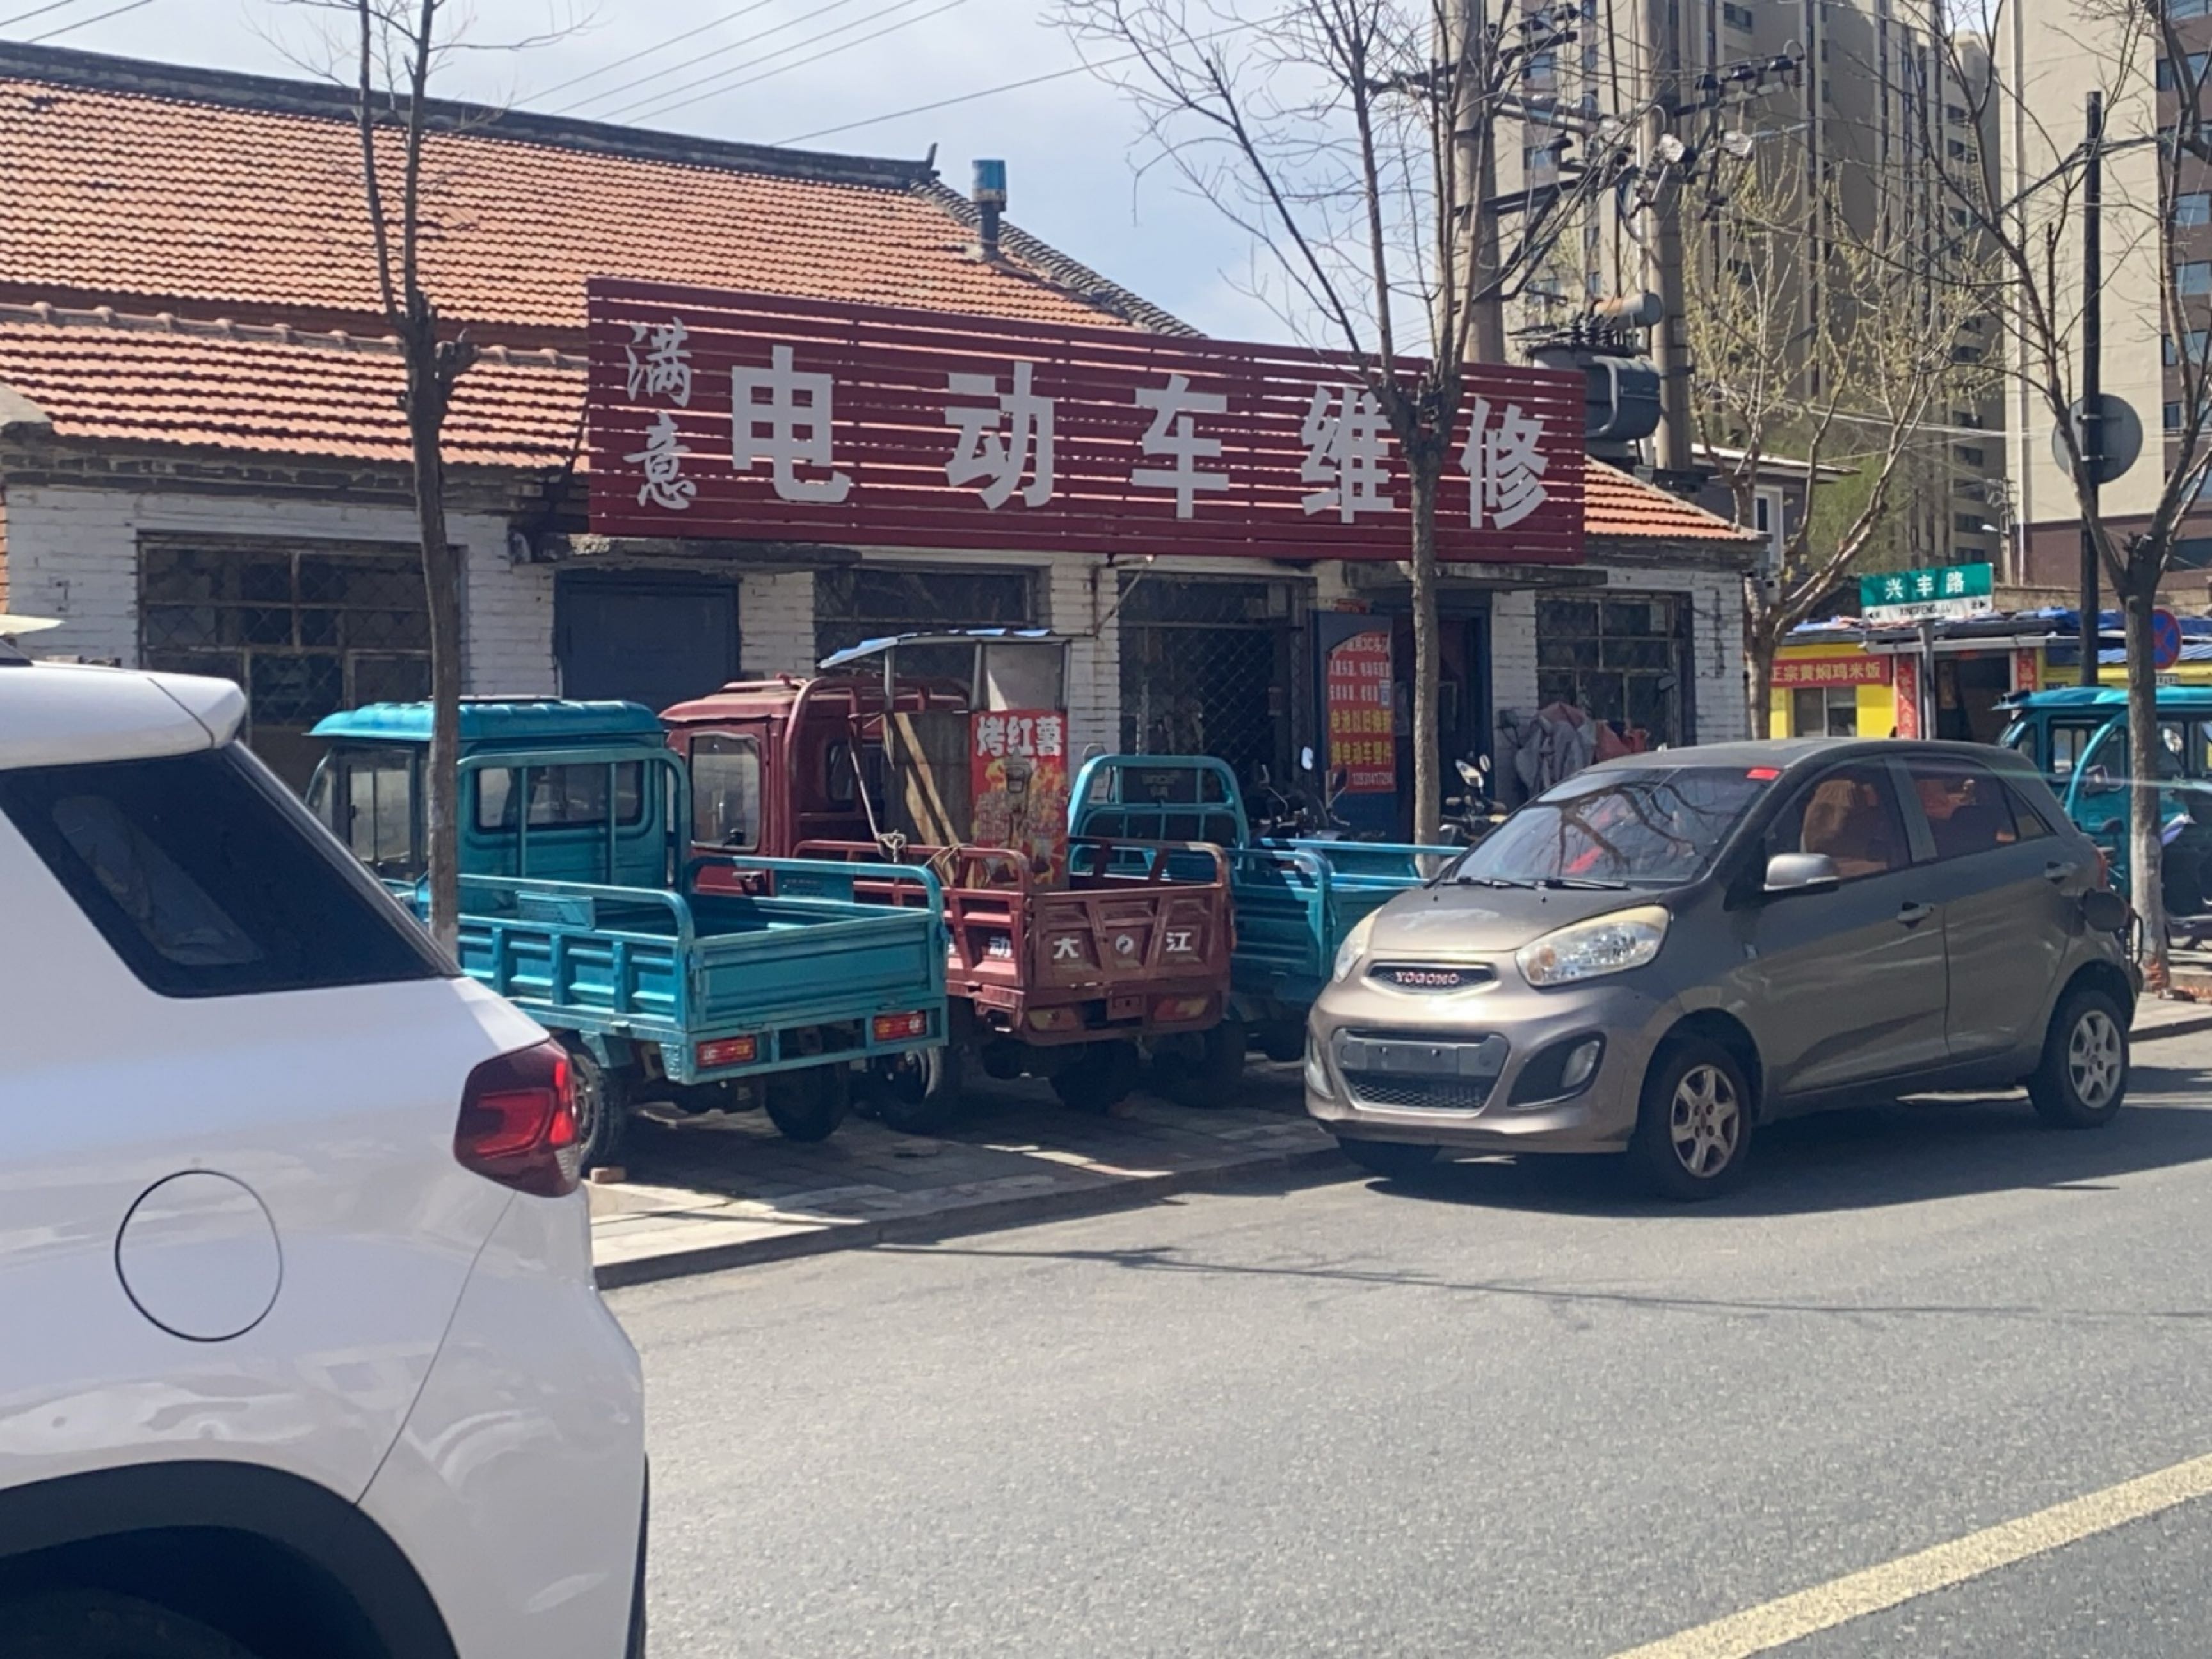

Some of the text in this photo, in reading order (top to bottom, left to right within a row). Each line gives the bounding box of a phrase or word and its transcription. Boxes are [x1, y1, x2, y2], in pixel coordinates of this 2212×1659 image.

[624, 316, 696, 511] 满意
[731, 345, 1550, 531] 电动车维修
[1885, 570, 1964, 600] 兴丰路
[1771, 662, 1880, 682] 正宗黄焖鸡米饭
[977, 716, 1062, 757] 烤红薯
